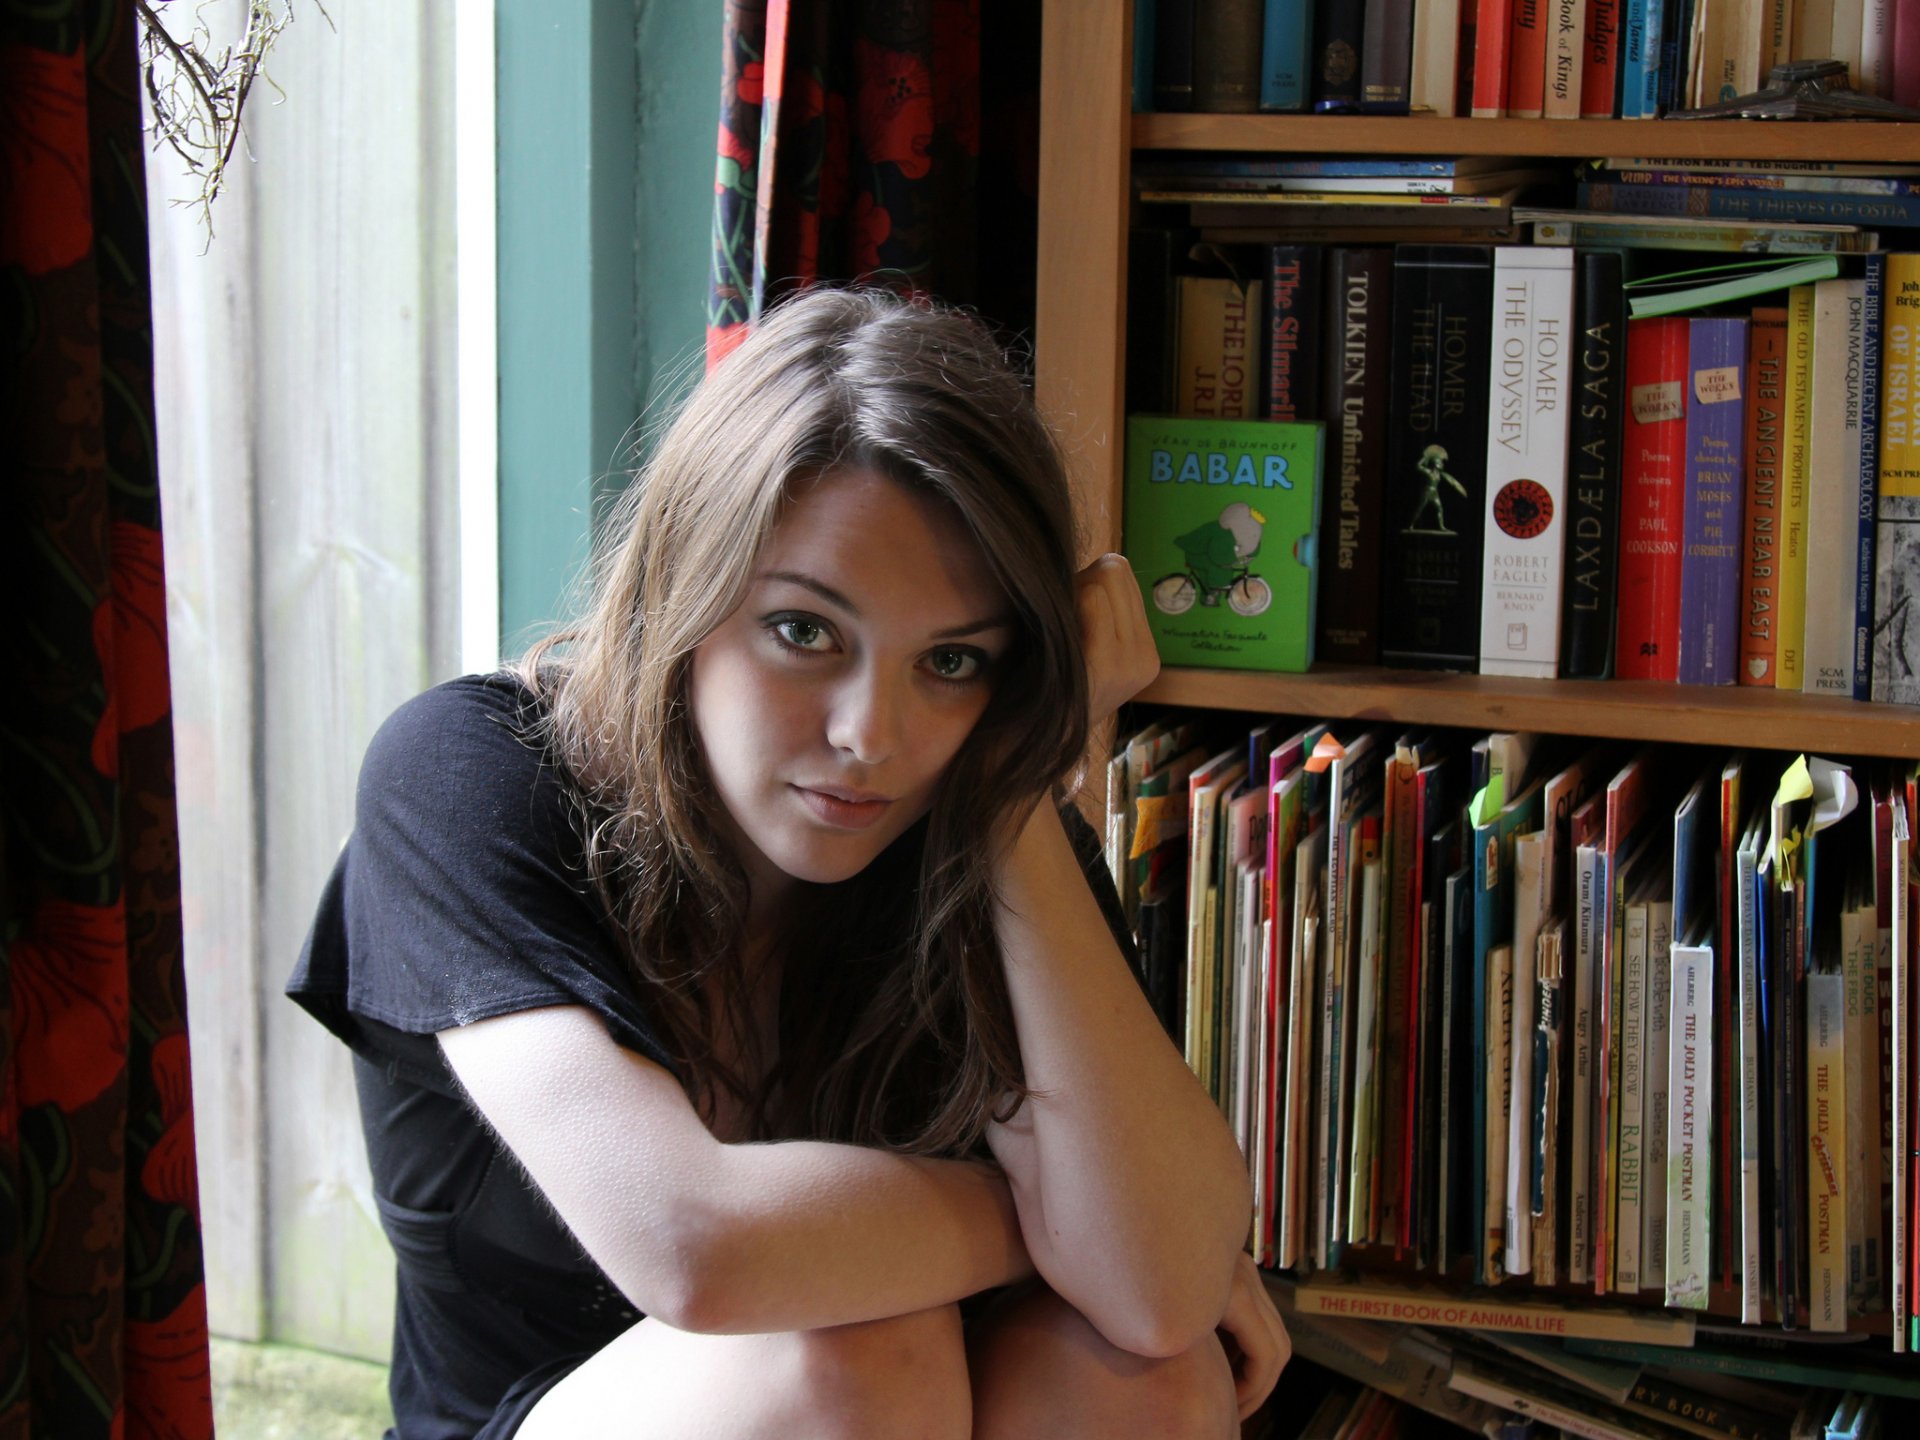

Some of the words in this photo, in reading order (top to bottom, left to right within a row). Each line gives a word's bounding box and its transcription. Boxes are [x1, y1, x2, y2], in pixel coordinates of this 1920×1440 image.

[1588, 0, 1613, 64] Judges
[1875, 7, 1884, 36] JOHN
[1558, 39, 1570, 51] of
[1628, 21, 1642, 63] James
[1553, 55, 1572, 100] Kings
[1647, 158, 1669, 167] THE
[1673, 159, 1702, 168] IRON
[1704, 160, 1730, 168] MAN
[1750, 161, 1772, 170] TED
[1775, 162, 1822, 172] HUGHES
[1663, 174, 1679, 185] THE
[1725, 176, 1746, 187] EPIC
[1748, 177, 1785, 189] VOYAGE
[1719, 197, 1750, 213] THE
[1757, 198, 1825, 217] THIEVES
[1831, 200, 1854, 216] OF
[1858, 203, 1909, 220] OSTIA
[1273, 261, 1300, 309] The
[1865, 262, 1880, 291] THE
[1503, 280, 1528, 329] THE
[1797, 300, 1809, 327] THE
[1847, 296, 1862, 333] JOHN
[1864, 294, 1878, 332] BIBLE
[1223, 301, 1247, 349] THE
[1345, 271, 1370, 386] TOLKIEN
[1411, 303, 1435, 353] THE
[1889, 324, 1910, 357] OF
[1796, 331, 1808, 360] OLD
[1863, 336, 1877, 368] AND
[1441, 315, 1468, 418] HOMER
[1534, 318, 1560, 416] HOMER
[1581, 322, 1612, 418] SAGA
[1708, 374, 1727, 384] THE
[1759, 358, 1780, 400] THE
[1844, 335, 1860, 431] MACQUARRIE
[1408, 364, 1433, 432] ILIAD
[1496, 337, 1525, 455] ODYSSEY
[1700, 381, 1735, 393] WORKS
[1793, 364, 1808, 441] TESTAMENT
[1862, 368, 1876, 420] RECENT
[1886, 364, 1908, 451] ISRAEL
[1340, 396, 1365, 512] Unfinished
[1641, 449, 1671, 462] Poems
[1694, 451, 1724, 464] chosen
[1727, 453, 1737, 466] by
[1702, 435, 1729, 448] Poems
[1754, 407, 1777, 508] ANCIENT
[1150, 449, 1294, 490] BABAR
[1638, 471, 1672, 486] chosen
[1697, 471, 1733, 484] BRIAN
[1790, 444, 1804, 508] PROPHETS
[1859, 424, 1875, 522] ARCHAEOLOGY
[1882, 469, 1902, 479] SCM
[1648, 495, 1660, 511] by
[1696, 490, 1733, 503] MOSES
[1704, 508, 1723, 519] and
[1338, 515, 1360, 570] Tales
[1639, 518, 1668, 532] PAUL
[1704, 526, 1723, 539] PIE
[1788, 521, 1801, 558] Heaton
[1493, 553, 1550, 569] ROBERT
[1626, 540, 1679, 555] COOKSON
[1687, 544, 1737, 558] CORBETT
[1752, 516, 1775, 579] NEAR
[1860, 537, 1871, 572] Kathleen
[1492, 569, 1549, 584] FAGLES
[1860, 573, 1870, 582] M
[1496, 591, 1545, 602] BERNARD
[1503, 602, 1536, 613] KNOX
[1750, 586, 1771, 641] EAST
[1857, 583, 1869, 612] Kenyon
[1784, 648, 1796, 672] DLT
[1856, 626, 1869, 671] Colonnade
[1816, 679, 1847, 689] PRESS
[1819, 668, 1845, 678] SCM
[1329, 857, 1338, 903] EGYPTIAN
[1743, 865, 1753, 884] THE
[1328, 906, 1337, 934] ECHO
[1580, 870, 1593, 955] Oram/Kitamura
[1744, 887, 1754, 929] TWELVE
[1653, 922, 1670, 951] The
[1744, 929, 1754, 955] DAYS
[1628, 955, 1640, 977] SEE
[1744, 956, 1754, 970] OF
[1847, 949, 1859, 977] THE
[1863, 942, 1875, 970] THE
[1652, 952, 1670, 1002] Trouble
[1687, 966, 1695, 1006] AHLBERG
[1627, 980, 1640, 1014] HOW
[1744, 972, 1755, 1028] CHRISTMAS
[1847, 979, 1859, 1017] FROG
[1863, 975, 1875, 1016] DUCK
[1577, 1007, 1589, 1039] Angry
[1626, 1018, 1639, 1051] THEY
[1651, 1001, 1668, 1033] with
[1684, 1014, 1696, 1041] THE
[1819, 1005, 1829, 1047] AHLBERG
[1578, 1043, 1589, 1078] Arthur
[1626, 1053, 1639, 1097] GROW
[1684, 1044, 1696, 1081] JOLLY
[1817, 1064, 1828, 1092] THE
[1745, 1056, 1755, 1112] BUCHANAN
[1652, 1091, 1665, 1136] Babette
[1682, 1085, 1695, 1139] POCKET
[1816, 1096, 1829, 1135] JOLLY
[1620, 1124, 1640, 1208] RABBIT
[1650, 1138, 1664, 1164] Cole
[1681, 1143, 1693, 1201] POSTMAN
[1575, 1191, 1585, 1239] Andersen
[1818, 1193, 1831, 1255] POSTMAN
[1652, 1236, 1663, 1270] SMART
[1682, 1209, 1691, 1266] HEINEMANN
[1574, 1242, 1585, 1269] Press
[1822, 1267, 1833, 1322] HEINEMANN
[1318, 1295, 1348, 1313] THE
[1349, 1298, 1391, 1316] FIRST
[1392, 1302, 1442, 1321] BOOK
[1443, 1308, 1468, 1324] OF
[1469, 1311, 1533, 1330] ANIMAL
[1535, 1315, 1566, 1333] LIFE
[1666, 1397, 1718, 1425] BOOK
